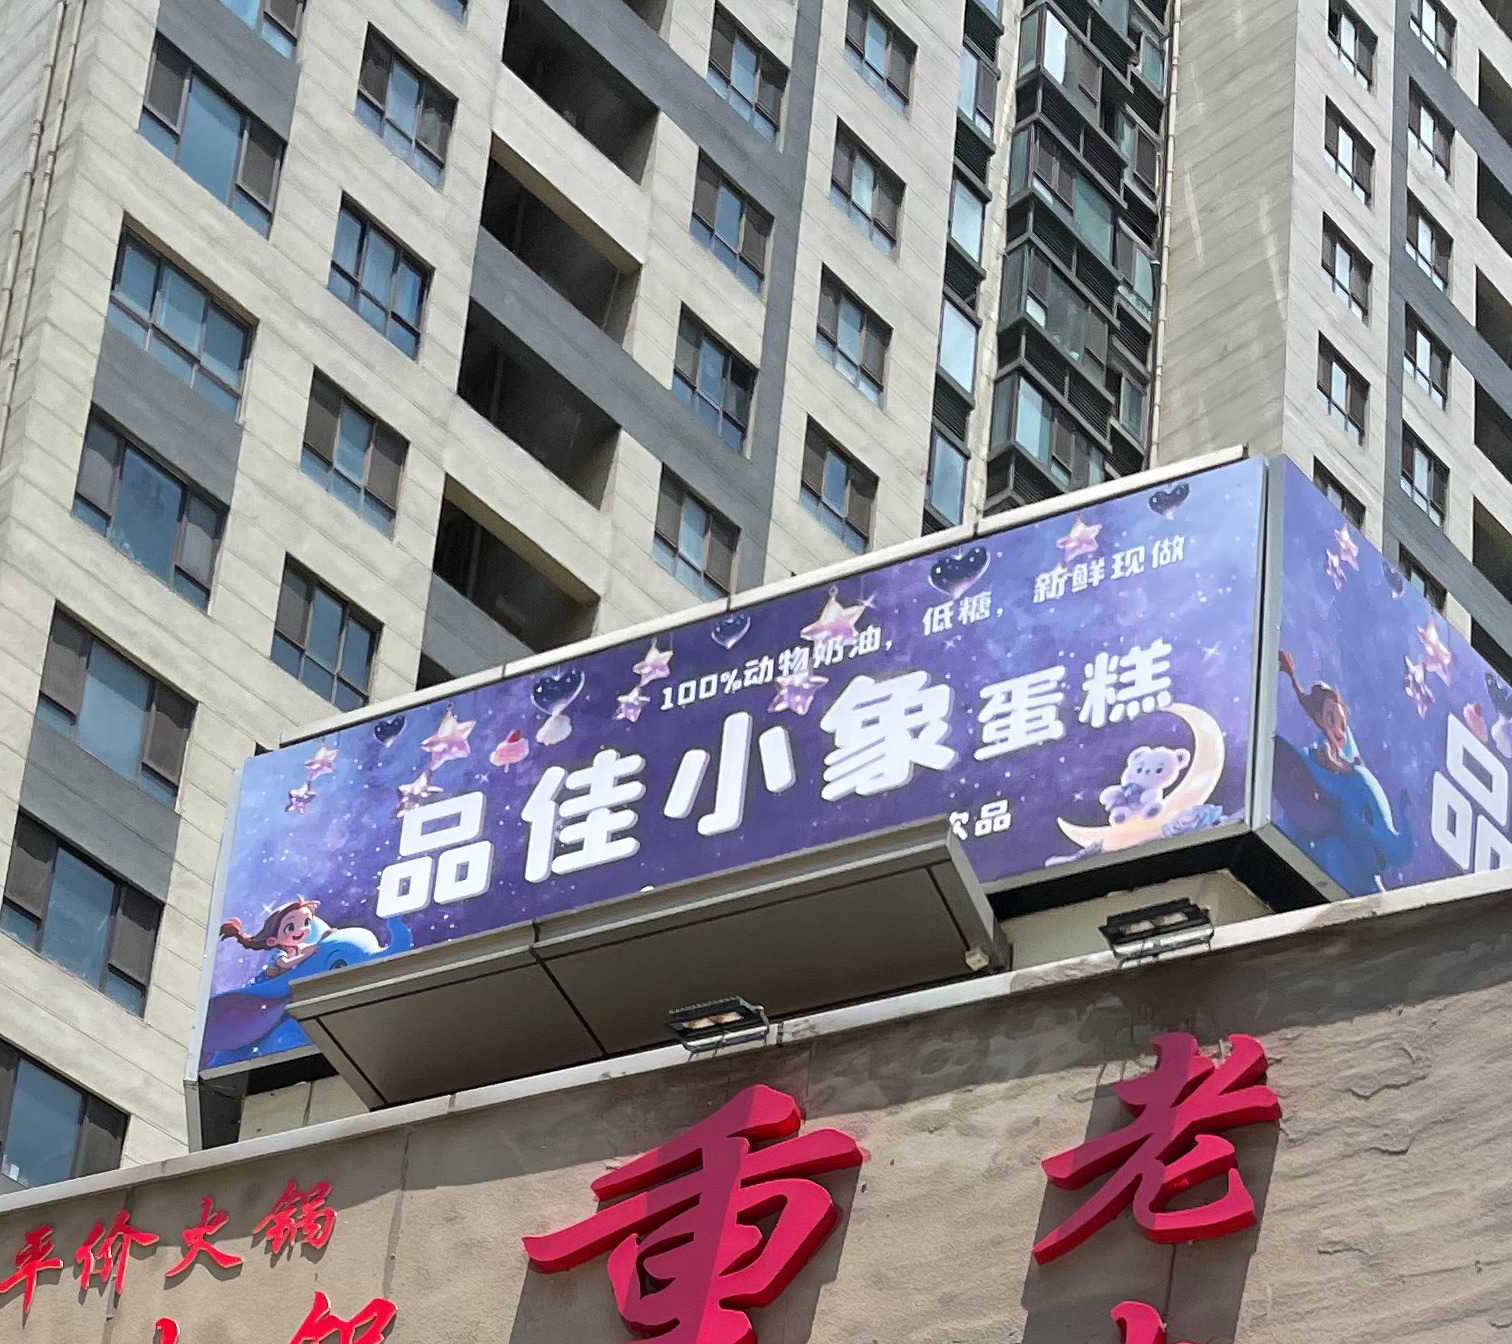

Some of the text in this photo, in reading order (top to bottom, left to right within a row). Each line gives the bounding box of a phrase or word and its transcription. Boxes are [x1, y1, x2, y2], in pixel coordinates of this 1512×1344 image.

[1033, 534, 1185, 604] 新鲜现做
[376, 638, 1173, 918] 品佳小象蛋糕
